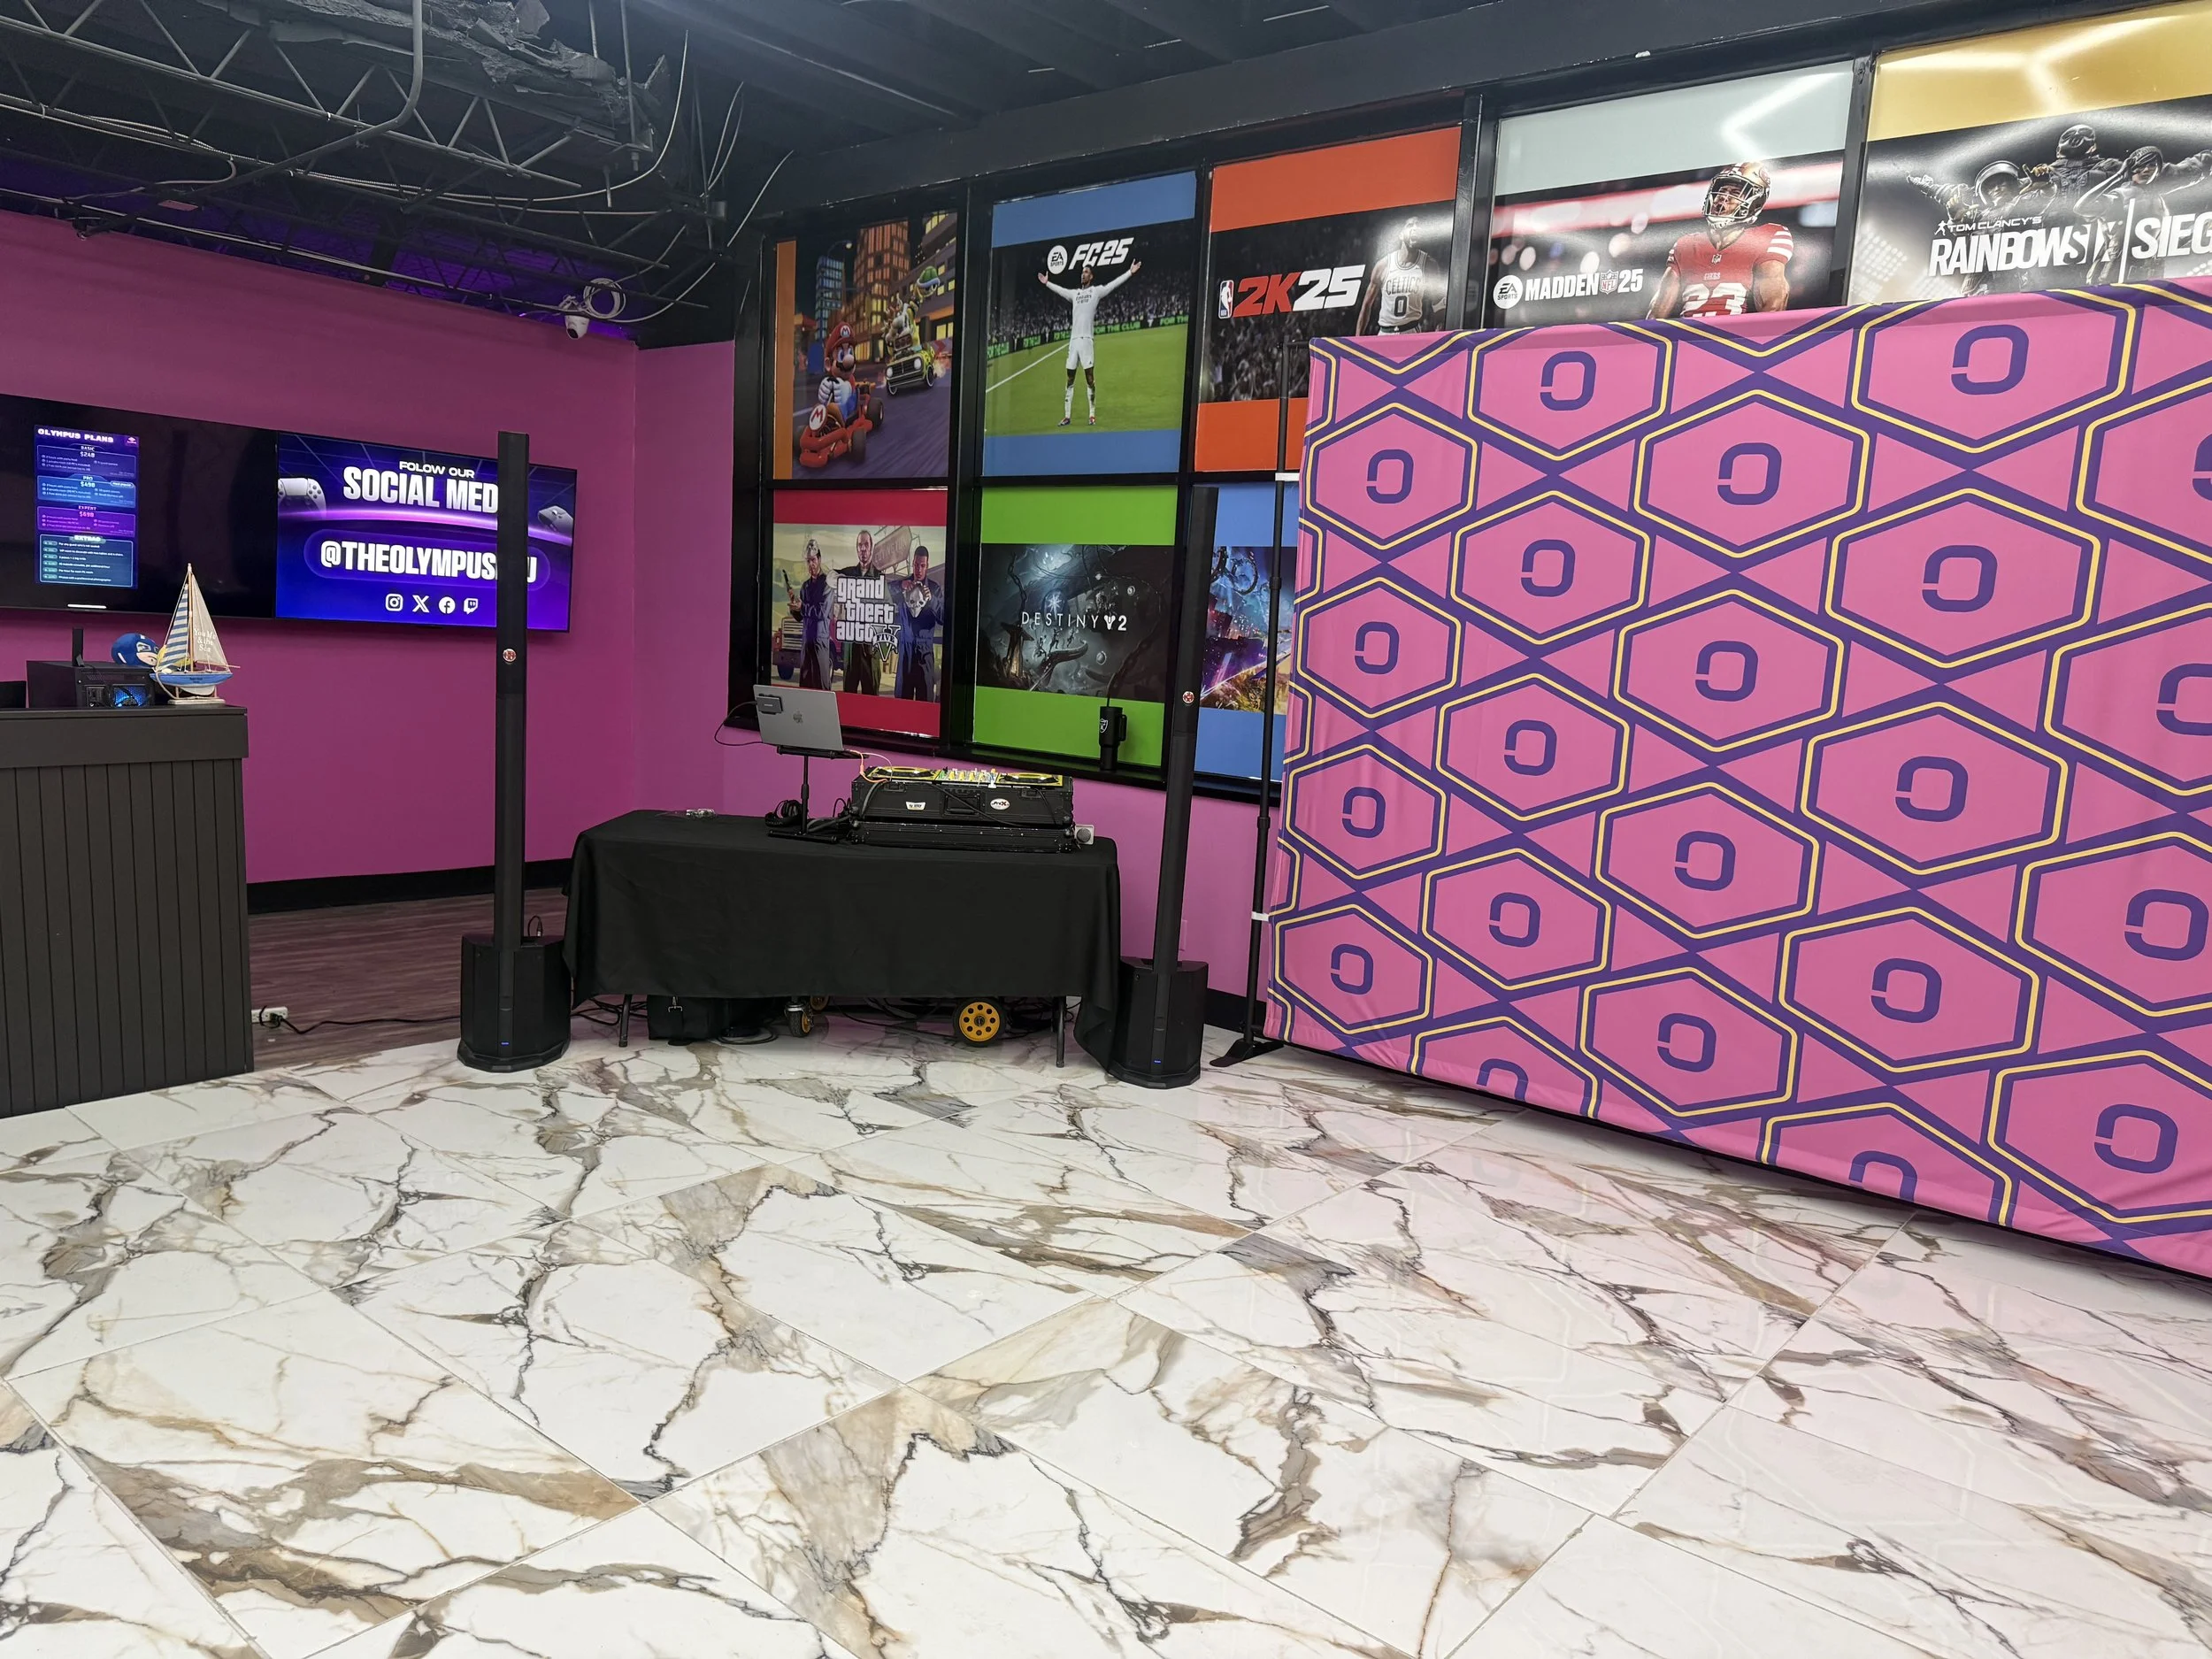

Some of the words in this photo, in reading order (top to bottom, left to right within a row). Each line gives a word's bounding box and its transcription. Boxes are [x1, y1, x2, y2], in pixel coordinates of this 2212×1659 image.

[1947, 223, 1977, 233] TOM
[1978, 216, 2042, 230] CLANCY'S
[1052, 252, 1064, 262] EA
[1386, 276, 1420, 296] CELTICS
[1500, 282, 1517, 294] EA
[1525, 273, 1600, 302] MADDEN
[1617, 269, 1643, 293] 25
[1681, 282, 1747, 318] 23
[37, 427, 81, 440] OLYMPUS
[84, 434, 114, 443] PLANS
[399, 460, 445, 475] FOLOW
[449, 466, 475, 479] OUR
[343, 465, 440, 508] SOCIAL
[446, 478, 499, 514] MED
[1021, 611, 1099, 629] DESTINY
[1118, 615, 1127, 631] 2
[194, 628, 205, 637] You
